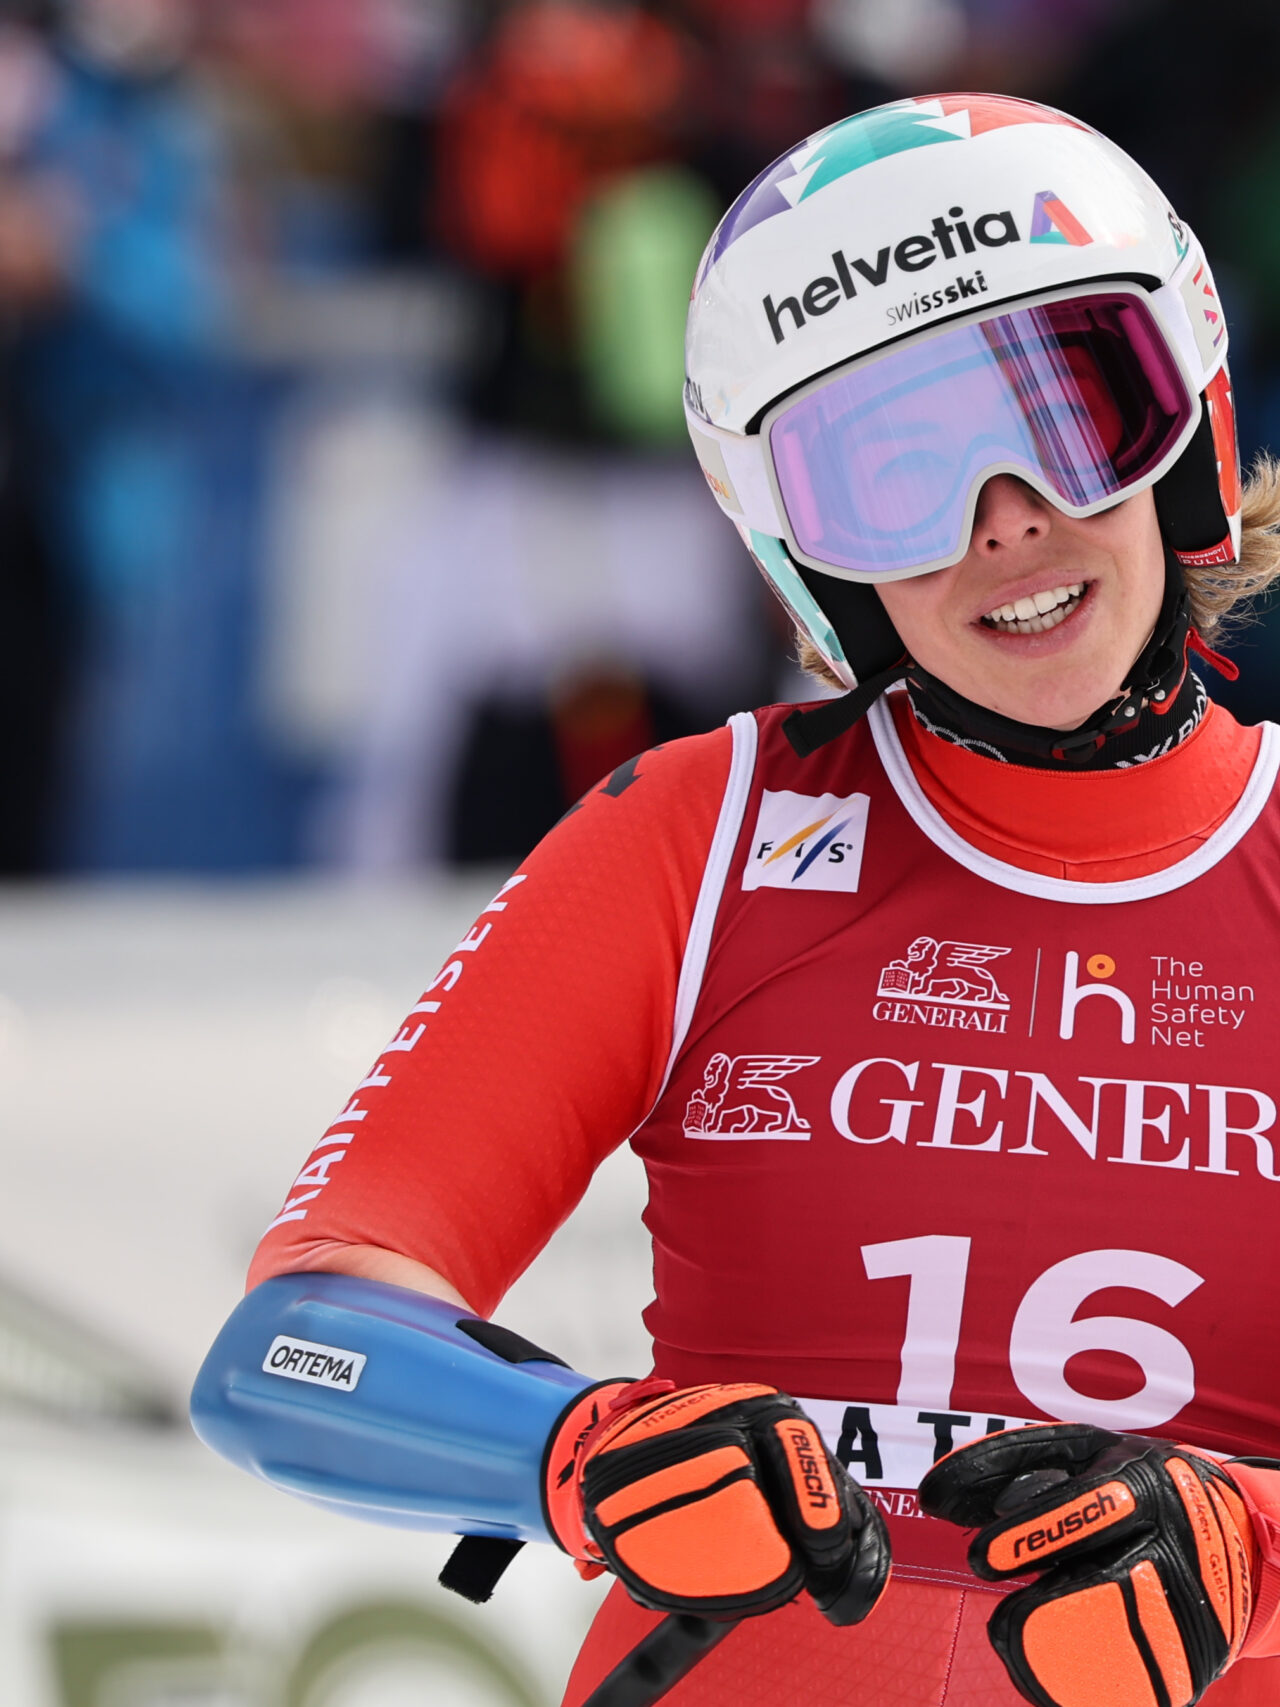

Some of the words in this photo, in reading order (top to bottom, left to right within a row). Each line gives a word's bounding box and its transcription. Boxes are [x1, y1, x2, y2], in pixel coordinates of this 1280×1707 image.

[762, 206, 1021, 345] helvetia
[1183, 556, 1225, 566] PULL
[1150, 956, 1203, 977] The
[1152, 980, 1254, 1002] Human
[872, 1001, 1009, 1034] GENERALI
[1151, 1003, 1245, 1030] Safety
[1152, 1026, 1205, 1047] Net
[860, 1234, 1206, 1430] 16
[270, 1345, 355, 1385] ORTEMA
[786, 1427, 833, 1508] reusch
[1013, 1491, 1116, 1558] reusch
